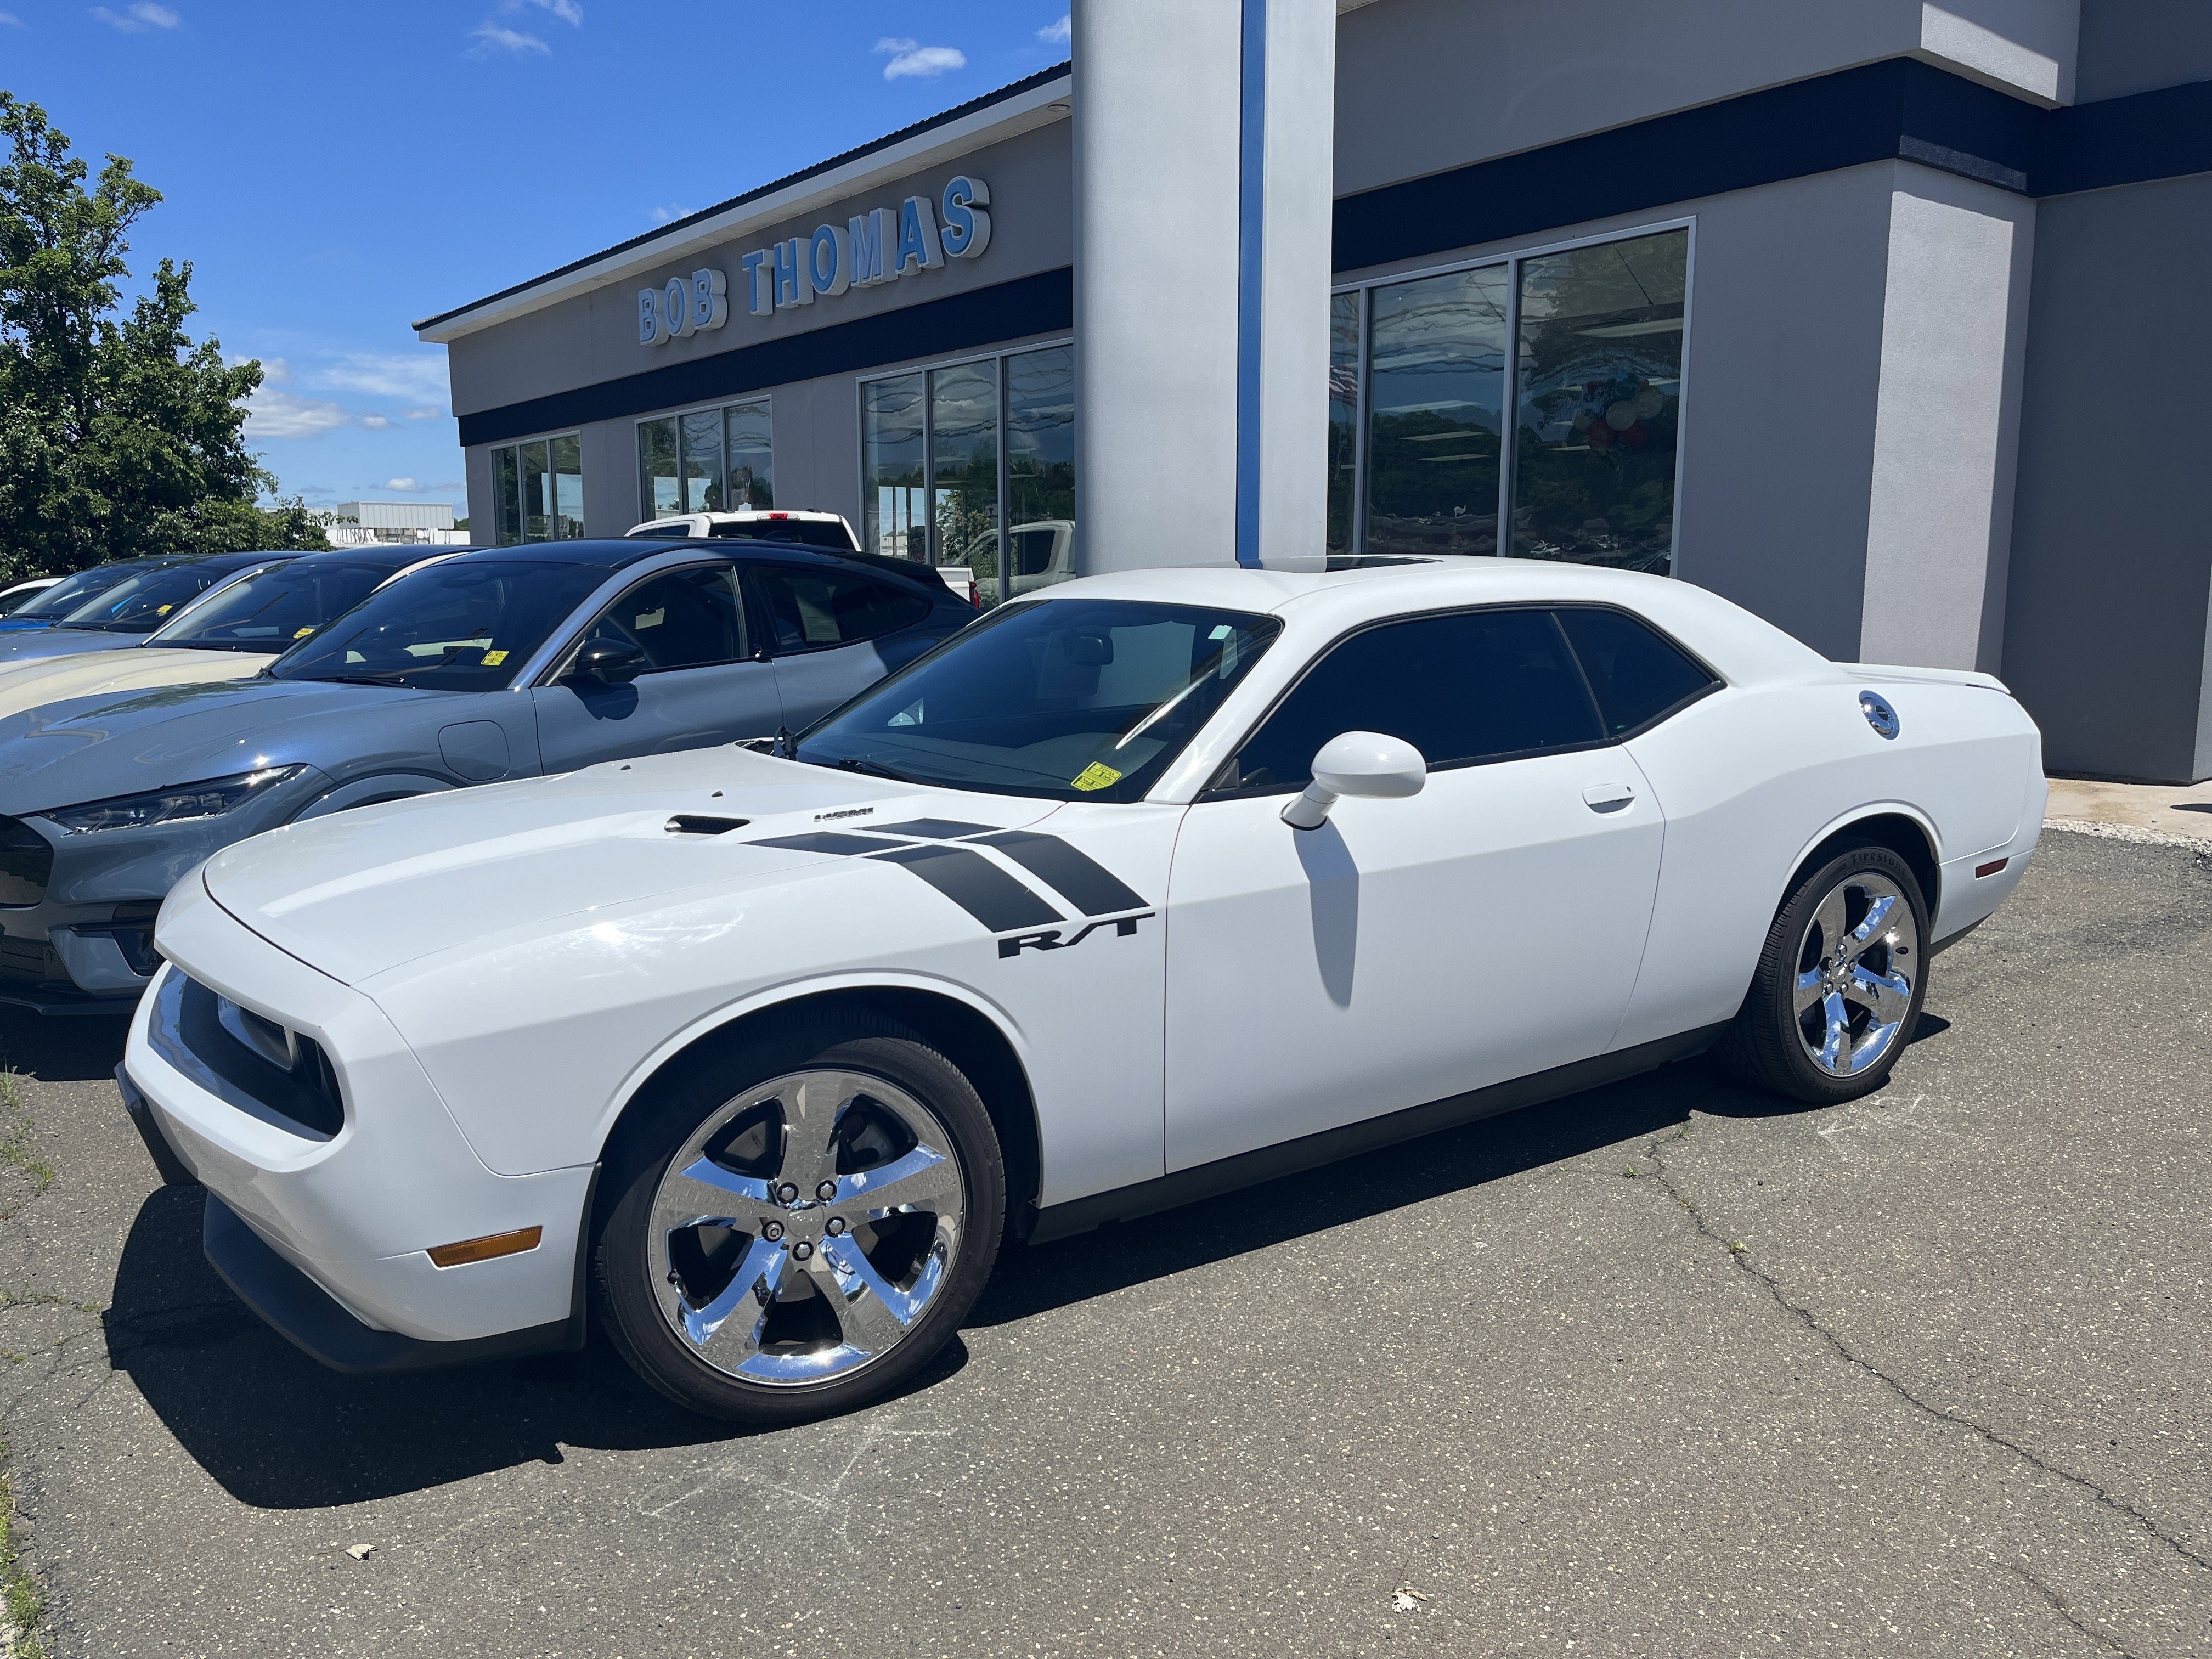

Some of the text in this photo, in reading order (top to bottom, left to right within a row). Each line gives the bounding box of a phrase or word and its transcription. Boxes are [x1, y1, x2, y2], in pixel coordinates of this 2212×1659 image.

[639, 176, 991, 346] BOB THOMAS
[1850, 852, 1907, 877] Firestone
[998, 912, 1155, 959] R/T
